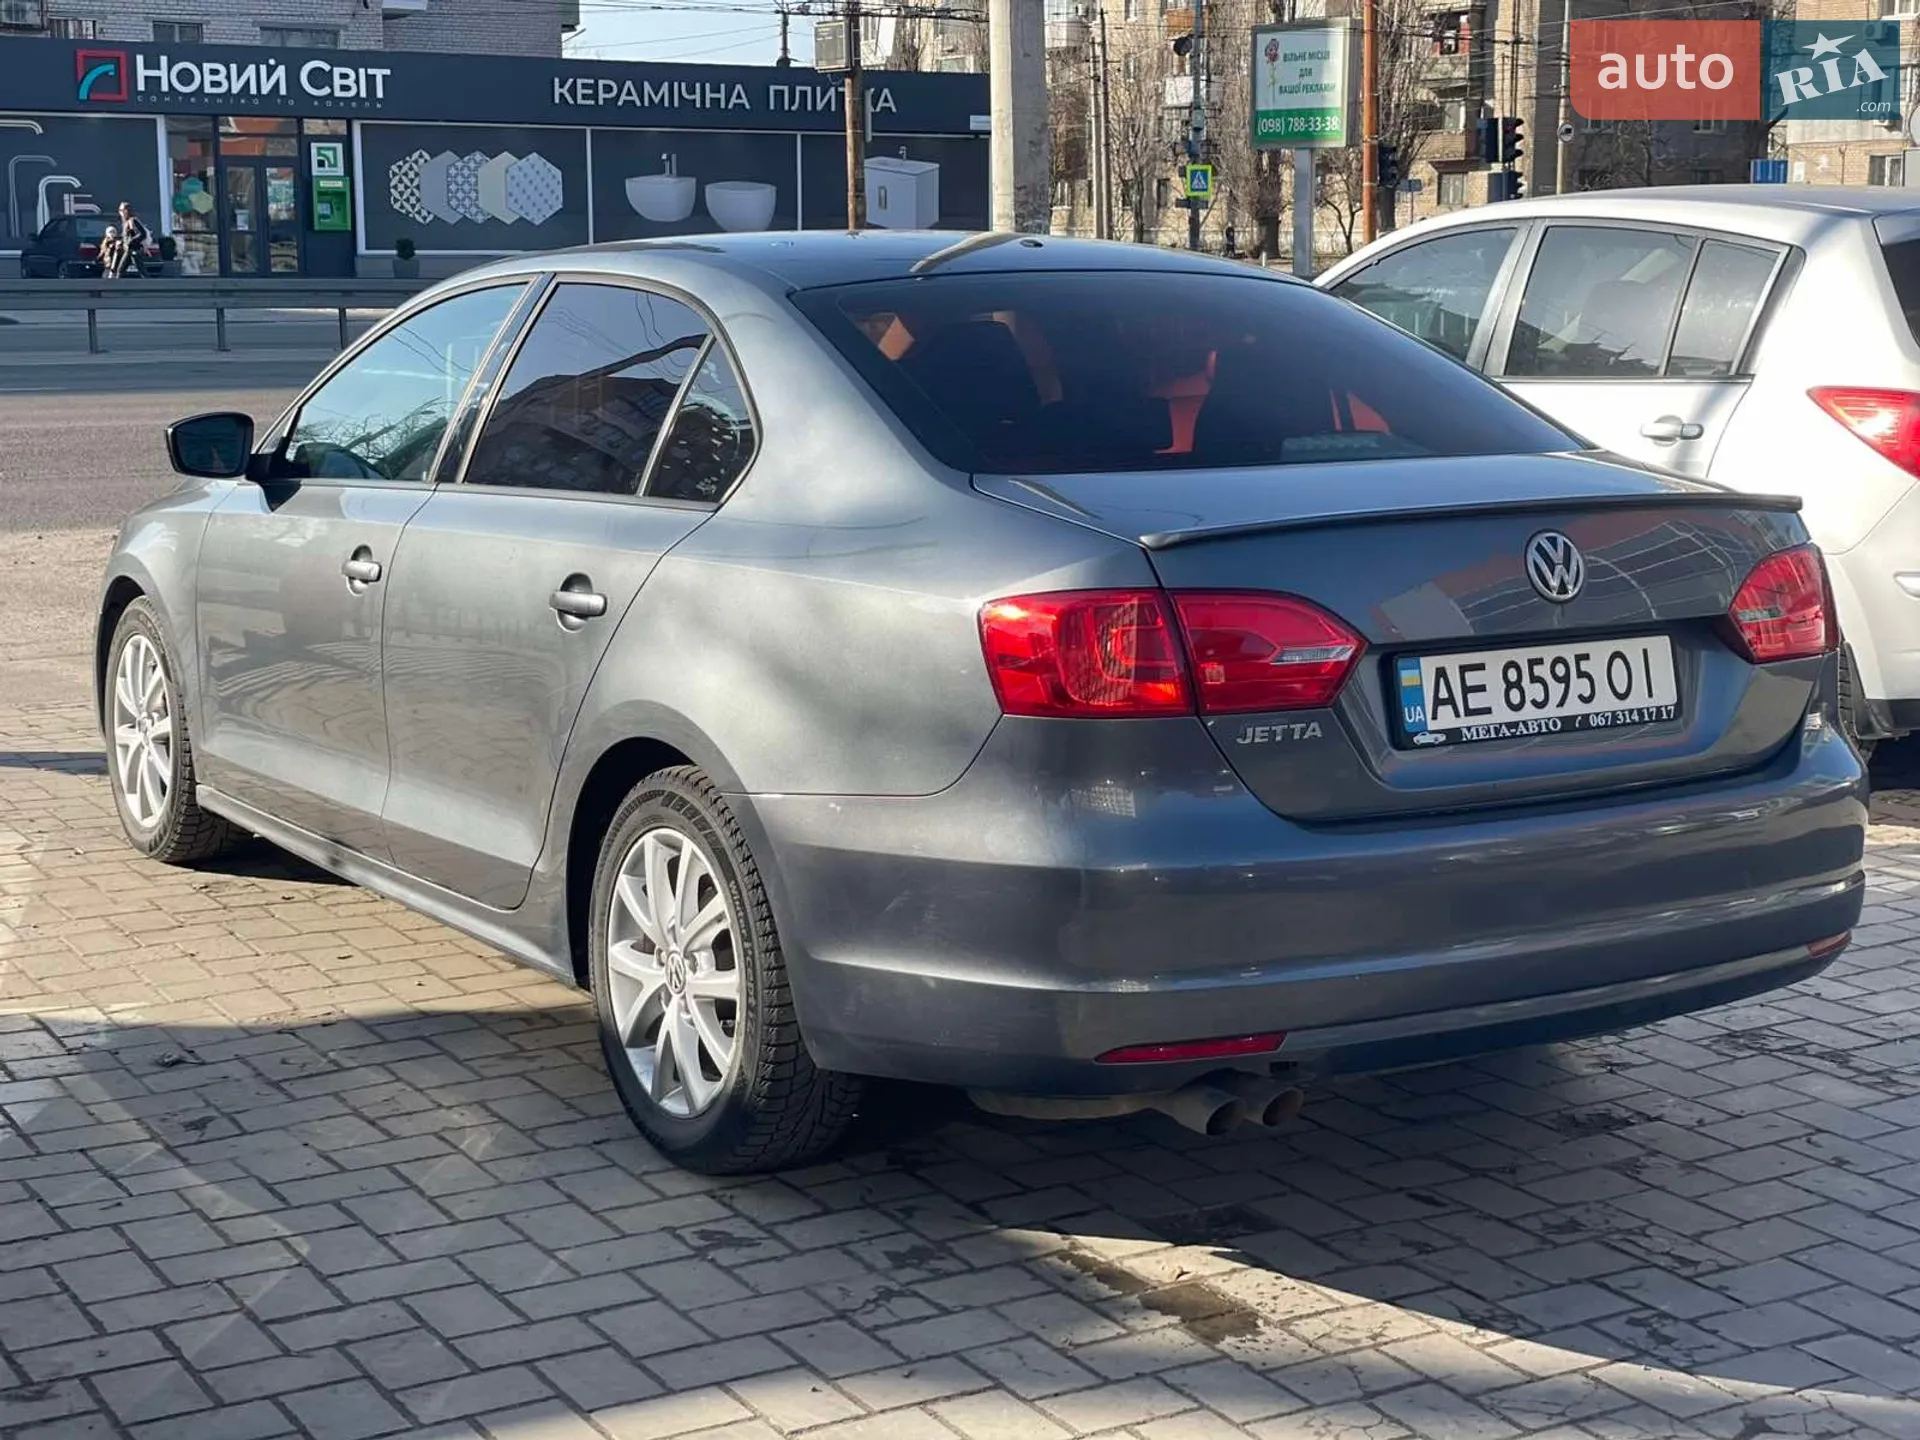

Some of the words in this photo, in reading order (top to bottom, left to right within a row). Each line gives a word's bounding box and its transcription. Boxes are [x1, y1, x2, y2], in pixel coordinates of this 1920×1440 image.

[553, 77, 750, 109] КЕРАМІЧНА
[769, 84, 897, 113] ПЛИА
[1258, 117, 1285, 135] (098)
[1288, 115, 1339, 132] 788-33-38
[1431, 662, 1493, 720] AE
[1502, 653, 1597, 712] 8595
[1404, 706, 1425, 723] UA
[1460, 718, 1561, 742] МЕГА-АВТО
[1588, 713, 1612, 728] 067
[1616, 710, 1639, 725] 314
[1644, 708, 1657, 722] 17
[1662, 706, 1675, 719] 17
[1236, 721, 1322, 744] JETTA
